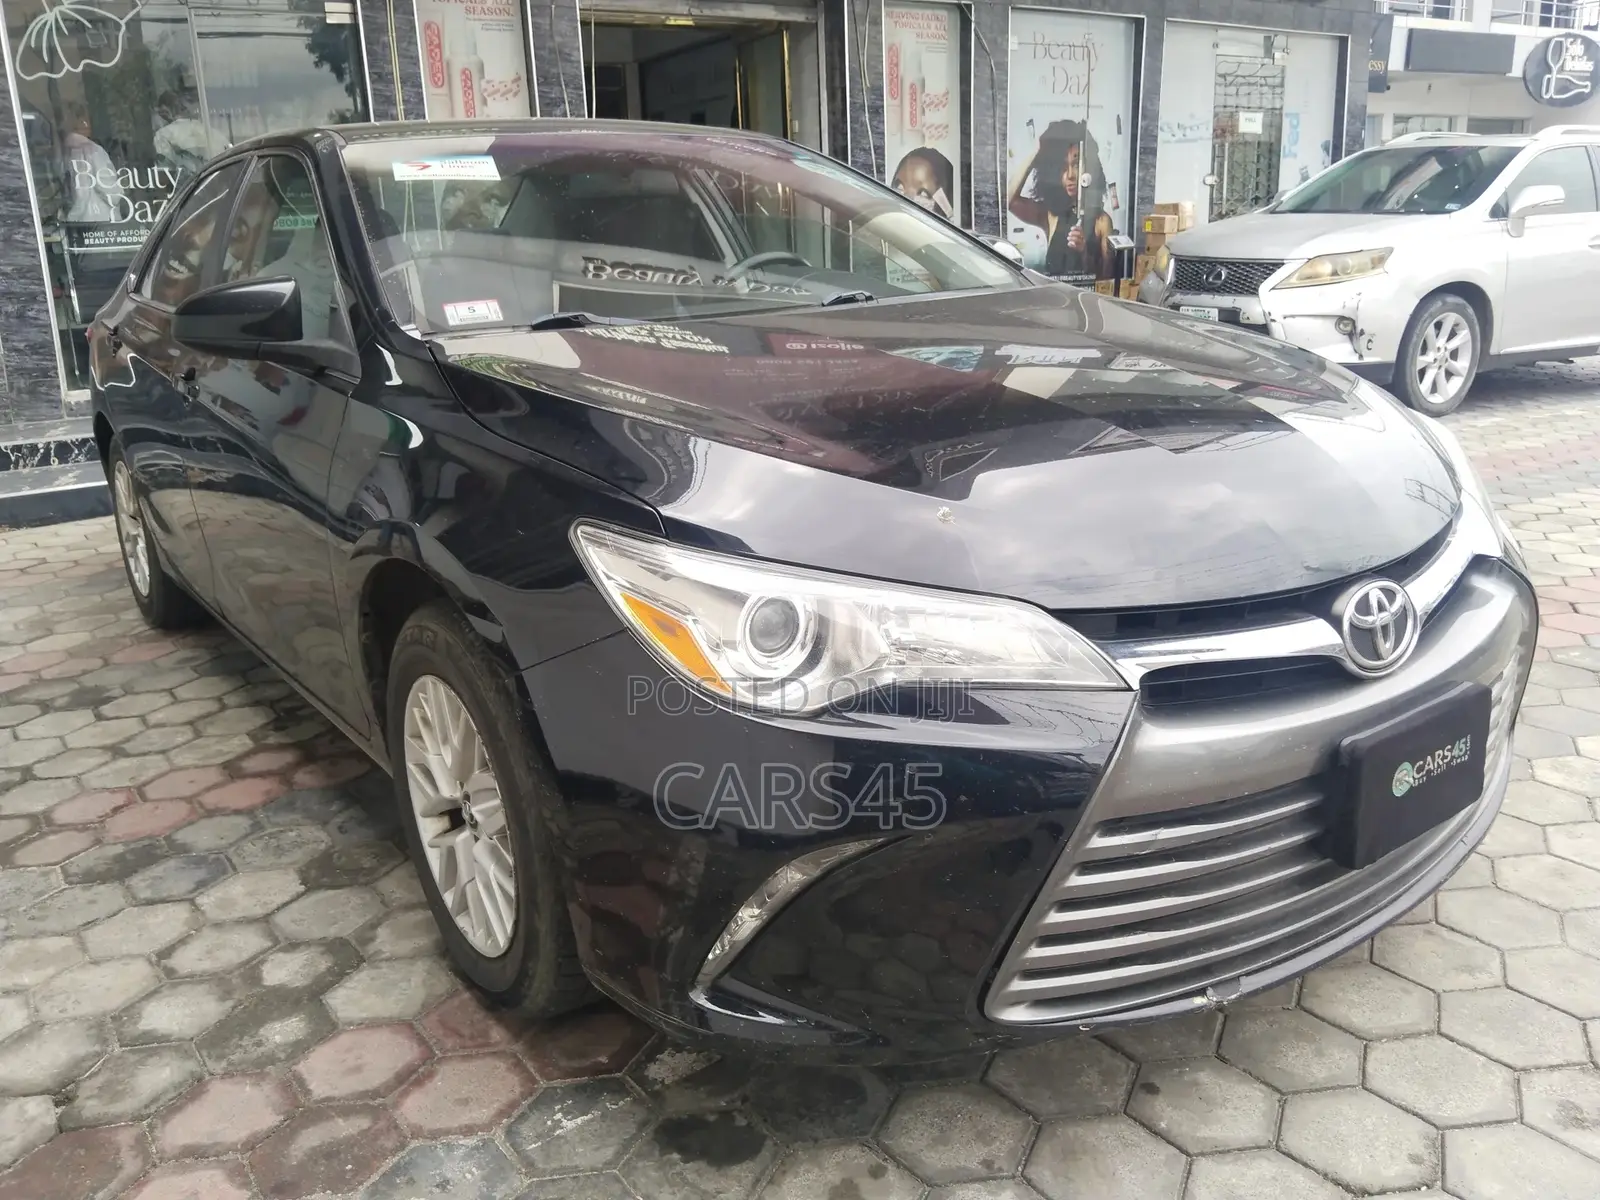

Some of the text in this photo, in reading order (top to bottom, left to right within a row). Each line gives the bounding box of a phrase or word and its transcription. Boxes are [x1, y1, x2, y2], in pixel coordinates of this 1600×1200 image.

[464, 6, 515, 17] SEASON.
[71, 158, 182, 198] Beauty
[84, 237, 115, 245] BEAUTY
[1413, 738, 1466, 779] CARS45
